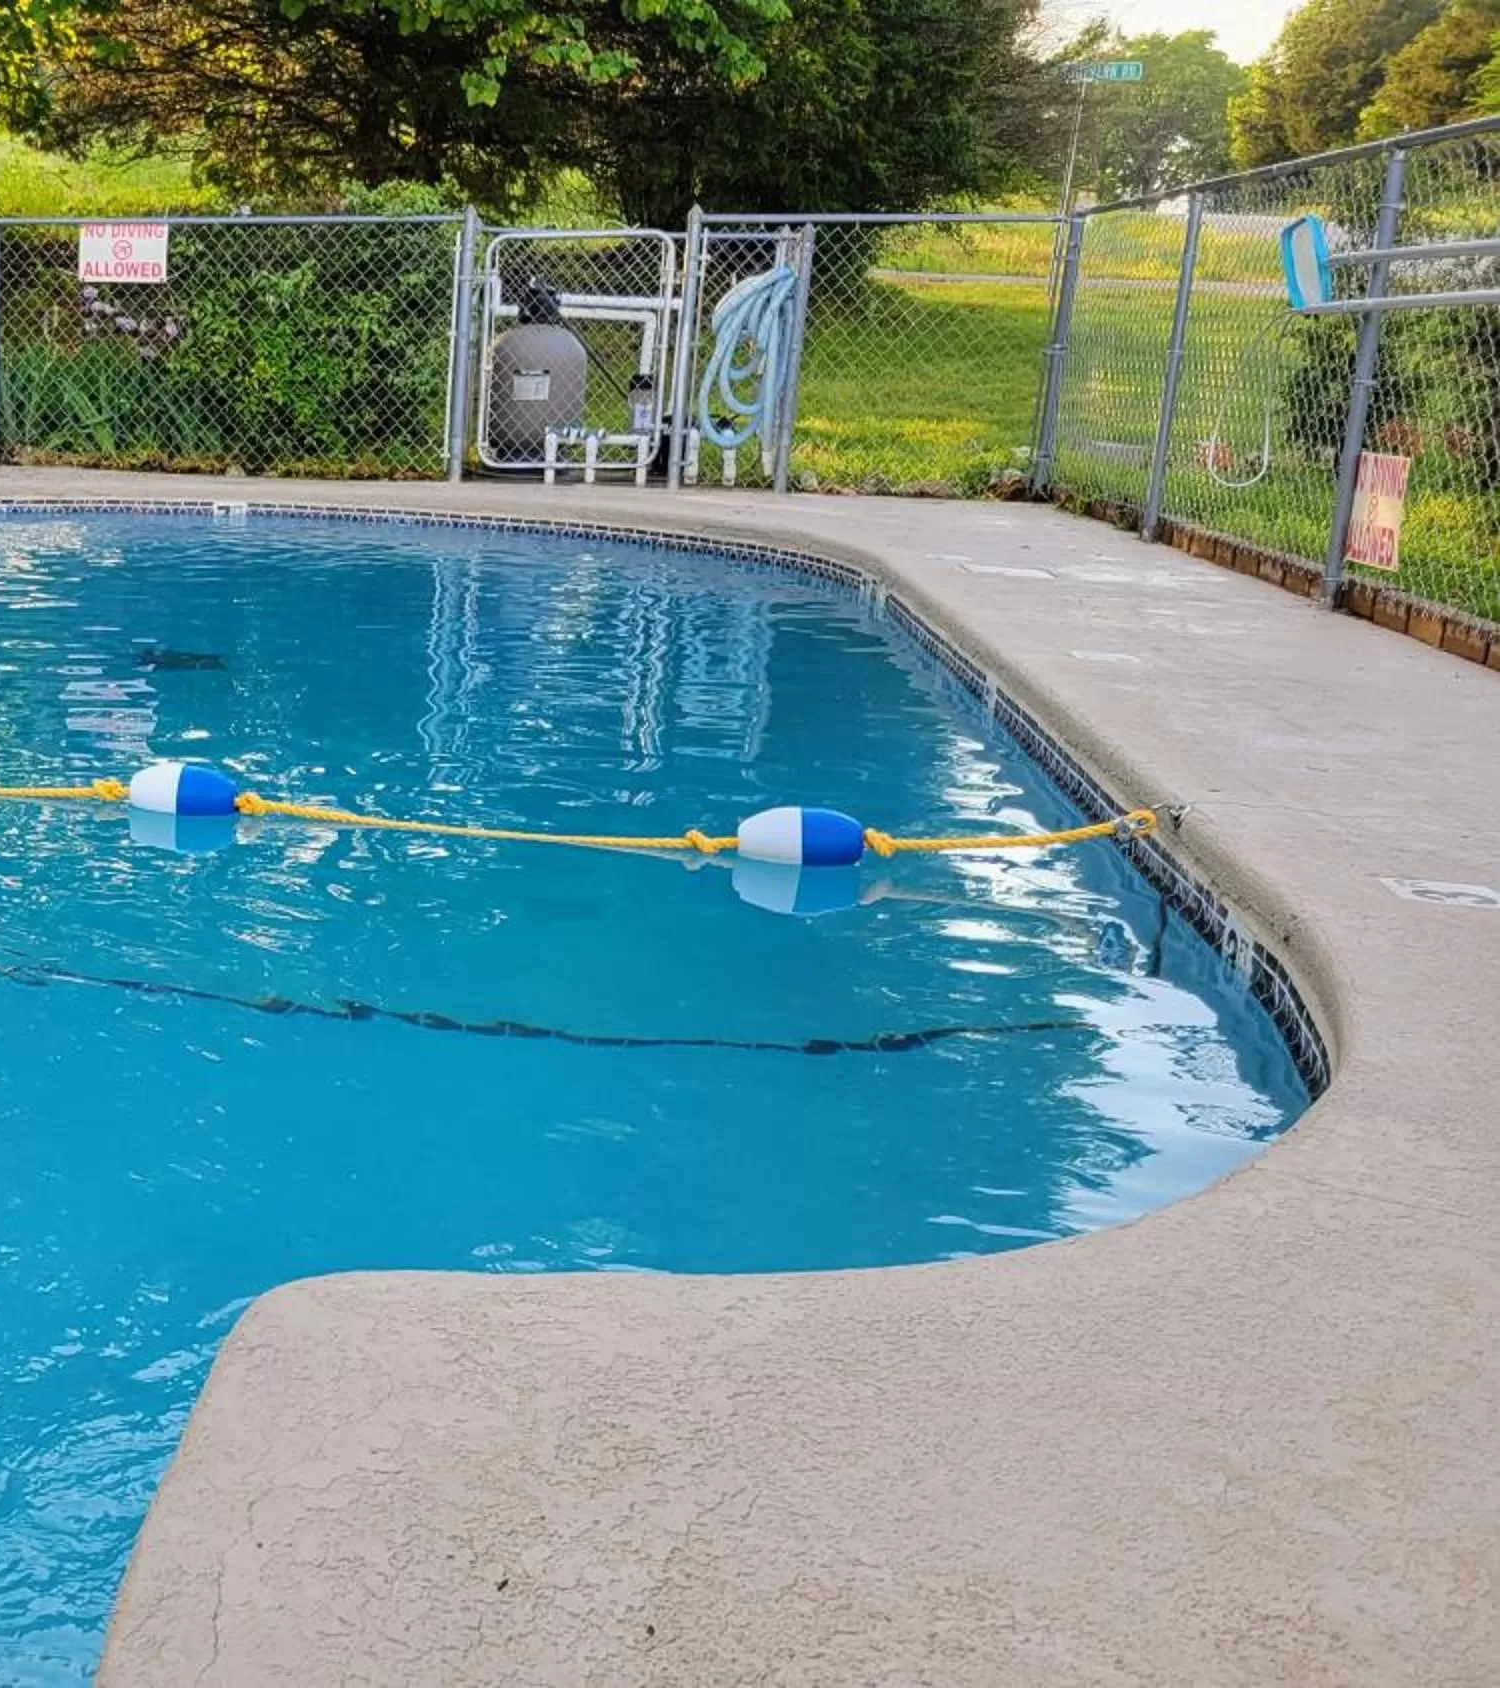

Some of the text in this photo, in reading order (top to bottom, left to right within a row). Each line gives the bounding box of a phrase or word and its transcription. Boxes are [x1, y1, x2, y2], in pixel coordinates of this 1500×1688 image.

[84, 224, 165, 238] NO DIVING
[84, 261, 163, 277] ALLOWED
